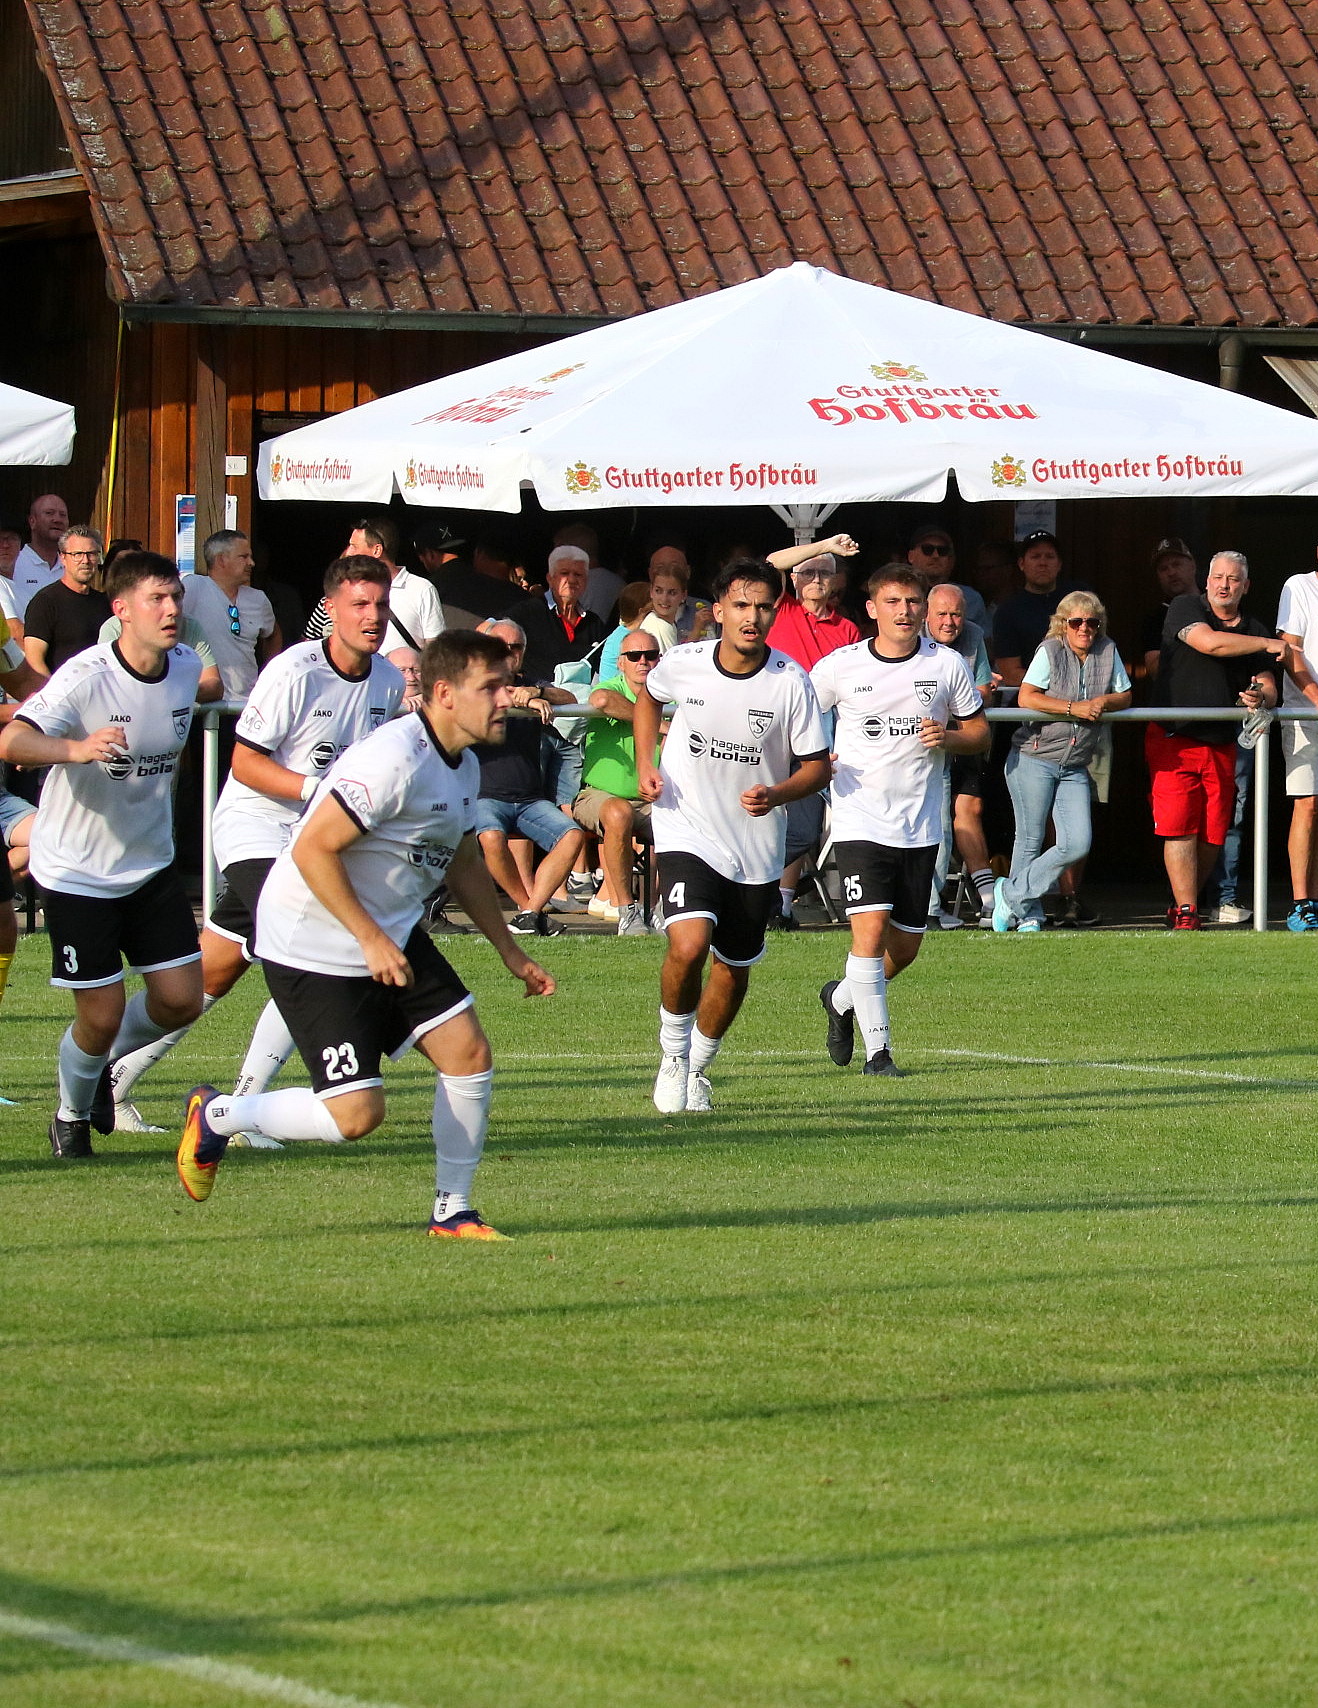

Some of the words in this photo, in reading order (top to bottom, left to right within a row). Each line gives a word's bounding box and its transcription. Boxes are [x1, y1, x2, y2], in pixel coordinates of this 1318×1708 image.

[836, 385, 1001, 399] Stuttgarter
[807, 398, 1041, 426] Hofbräu
[286, 458, 322, 486] Stuttgarter
[323, 458, 351, 484] Hofbräu
[418, 462, 455, 491] Stuttgarter
[457, 464, 485, 492] Hofbräu
[605, 465, 724, 494] Stuttgarter
[729, 463, 817, 491] Hofbräu
[1032, 458, 1150, 485] Stuttgarter
[1156, 455, 1243, 482] Hofbräu
[854, 685, 873, 693] JAKO
[686, 697, 704, 706] JAKO
[109, 714, 131, 723] JAKO
[313, 709, 332, 718] JAKO
[711, 737, 762, 754] hagebau
[710, 748, 761, 766] bolay
[431, 803, 448, 811] JAKO
[669, 882, 686, 908] 4
[844, 875, 863, 901] 25
[63, 945, 79, 973] 3
[869, 1025, 889, 1033] JAKO
[322, 1042, 359, 1081] 23
